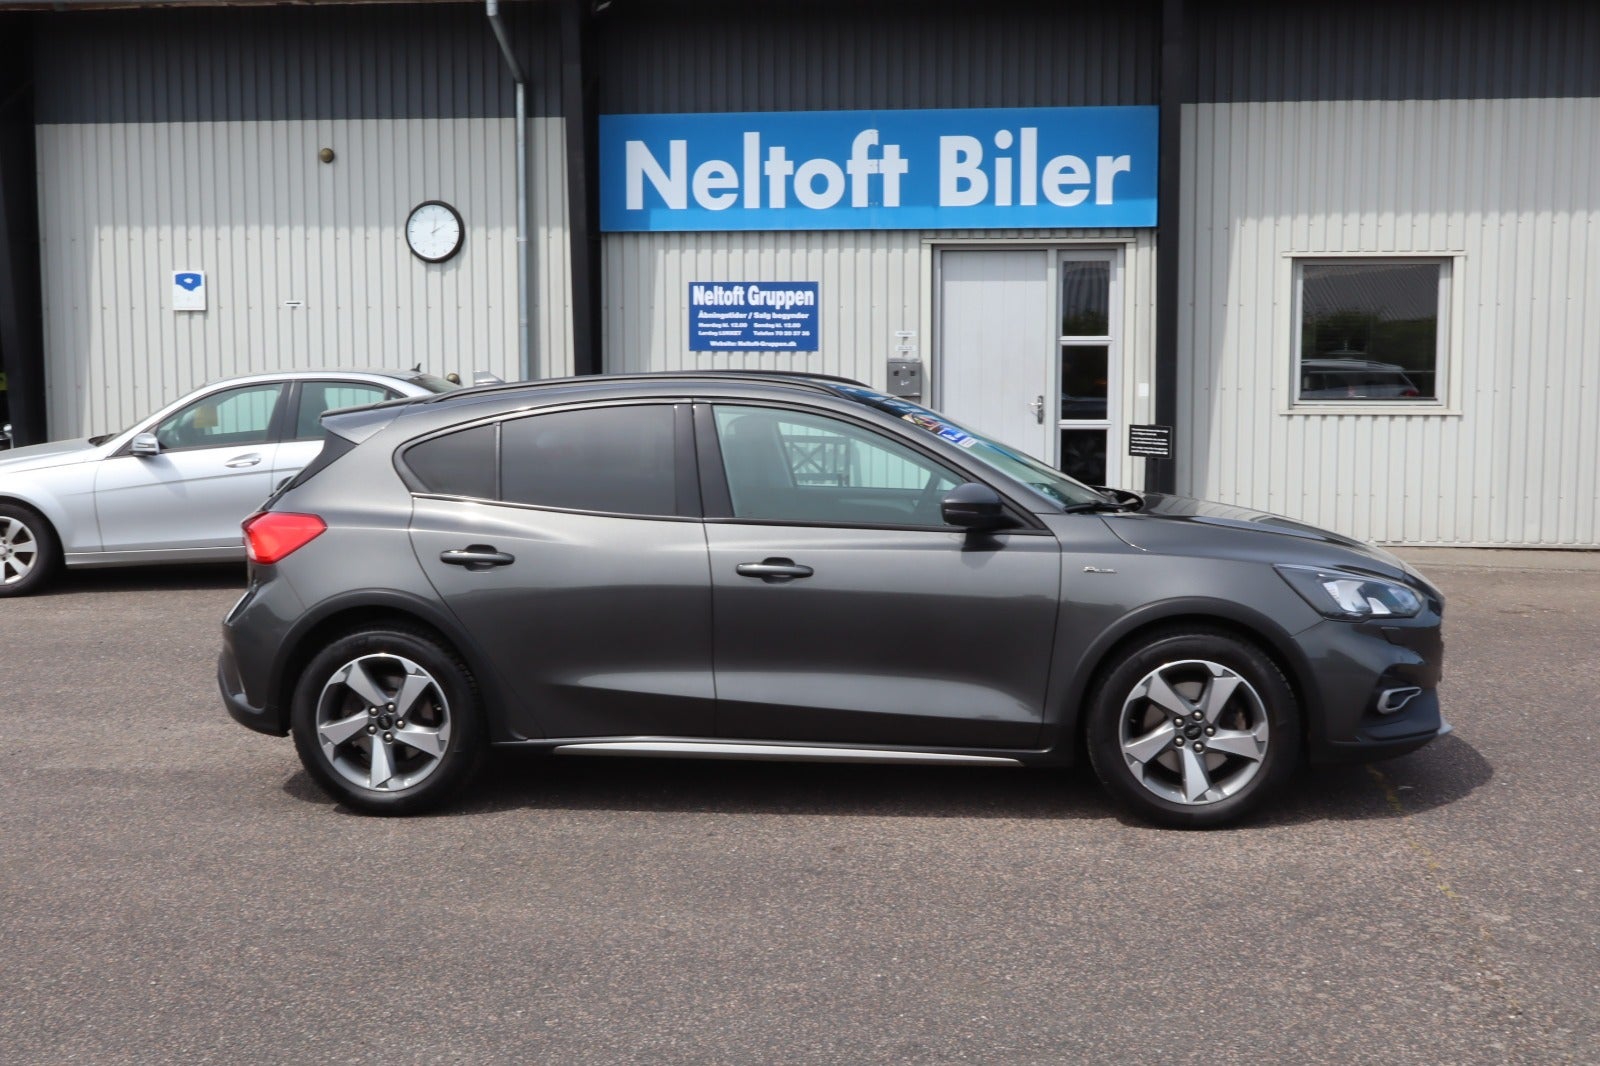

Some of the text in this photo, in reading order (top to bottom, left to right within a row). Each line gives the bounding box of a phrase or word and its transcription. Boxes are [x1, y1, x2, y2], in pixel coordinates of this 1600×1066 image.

[625, 127, 1131, 211] Neltoft Biler
[693, 285, 814, 310] Neltoft Gruppen
